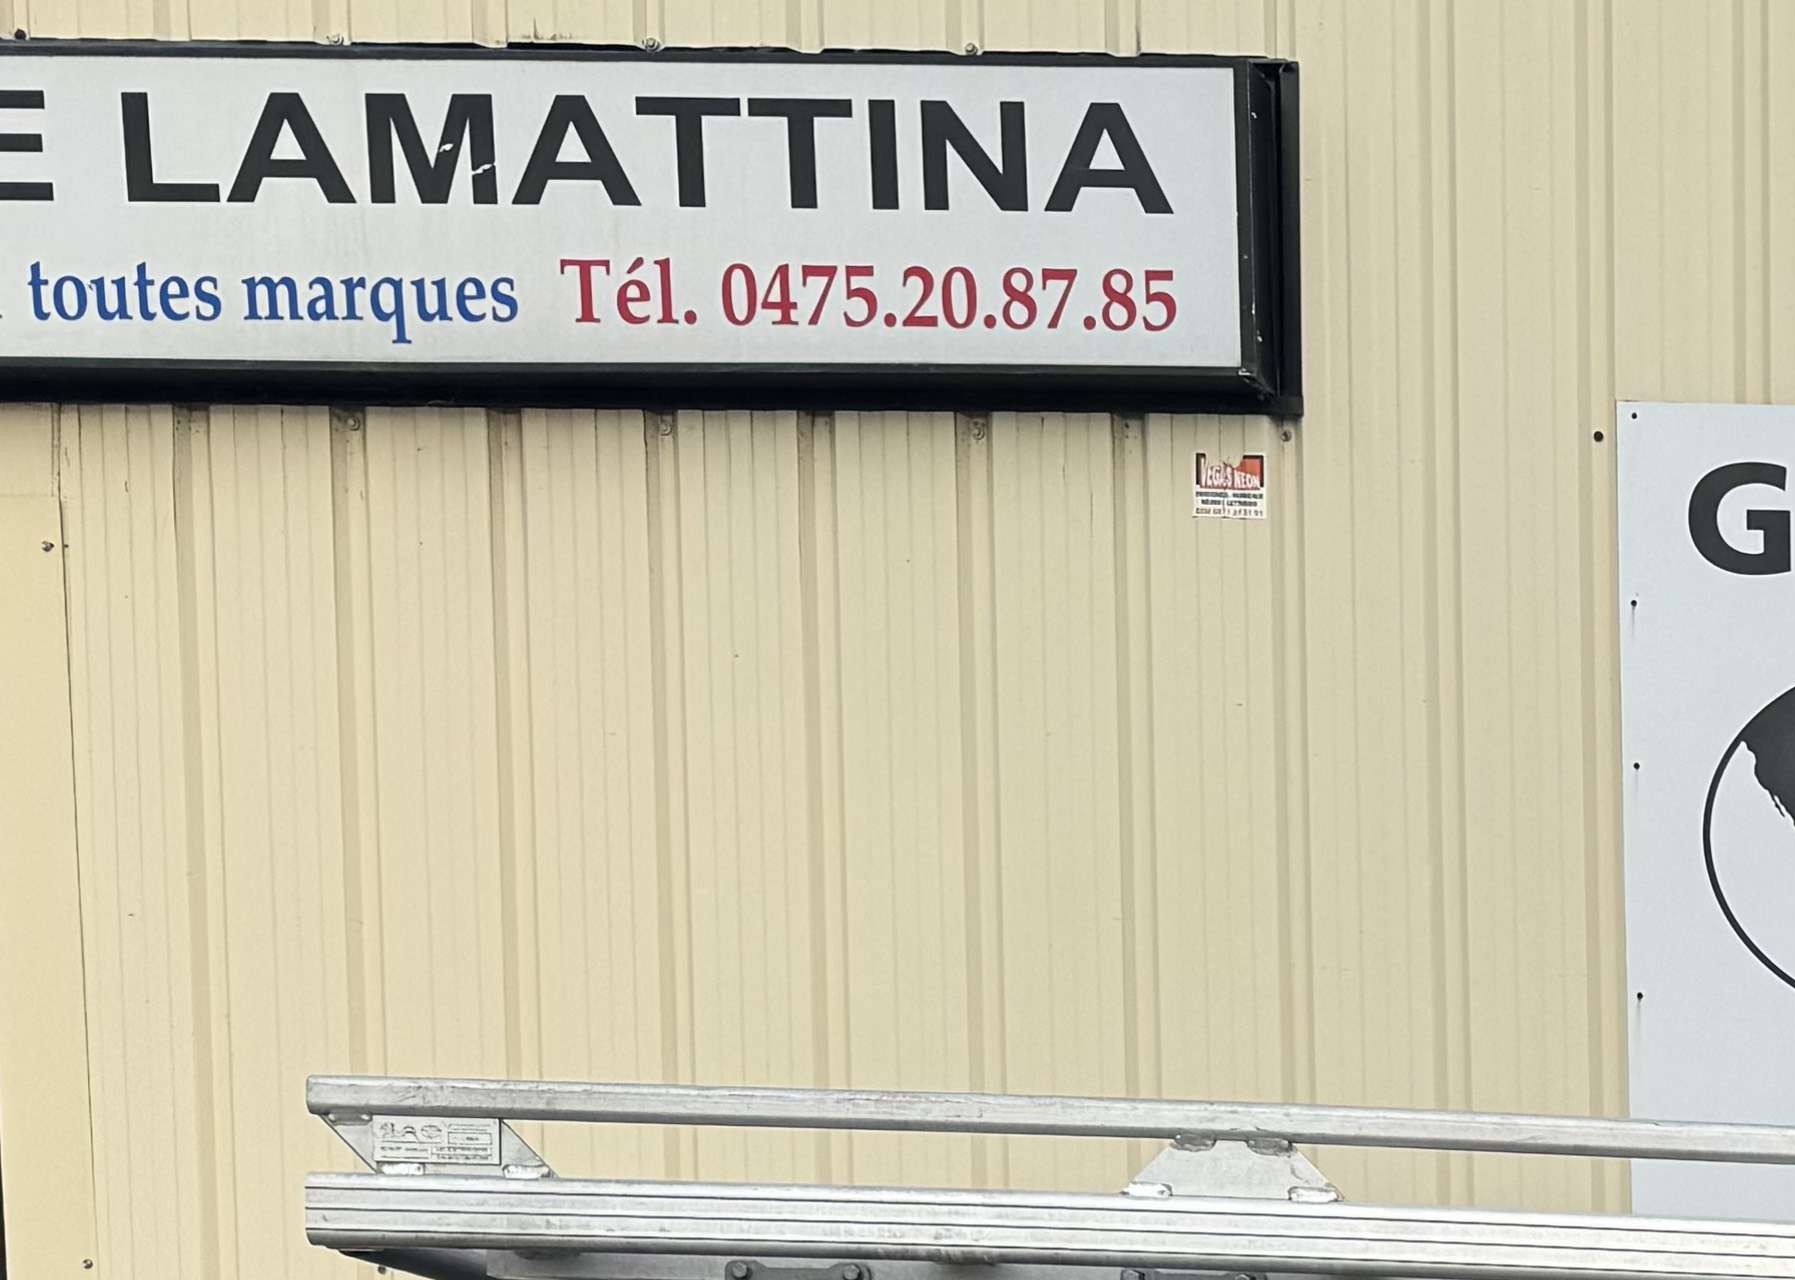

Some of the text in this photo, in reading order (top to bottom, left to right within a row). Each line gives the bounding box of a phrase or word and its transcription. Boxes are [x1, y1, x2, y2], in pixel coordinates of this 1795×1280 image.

[121, 91, 1174, 214] LAMATTINA
[28, 256, 1178, 344] toutes marques Tél. 0475.20.87.85
